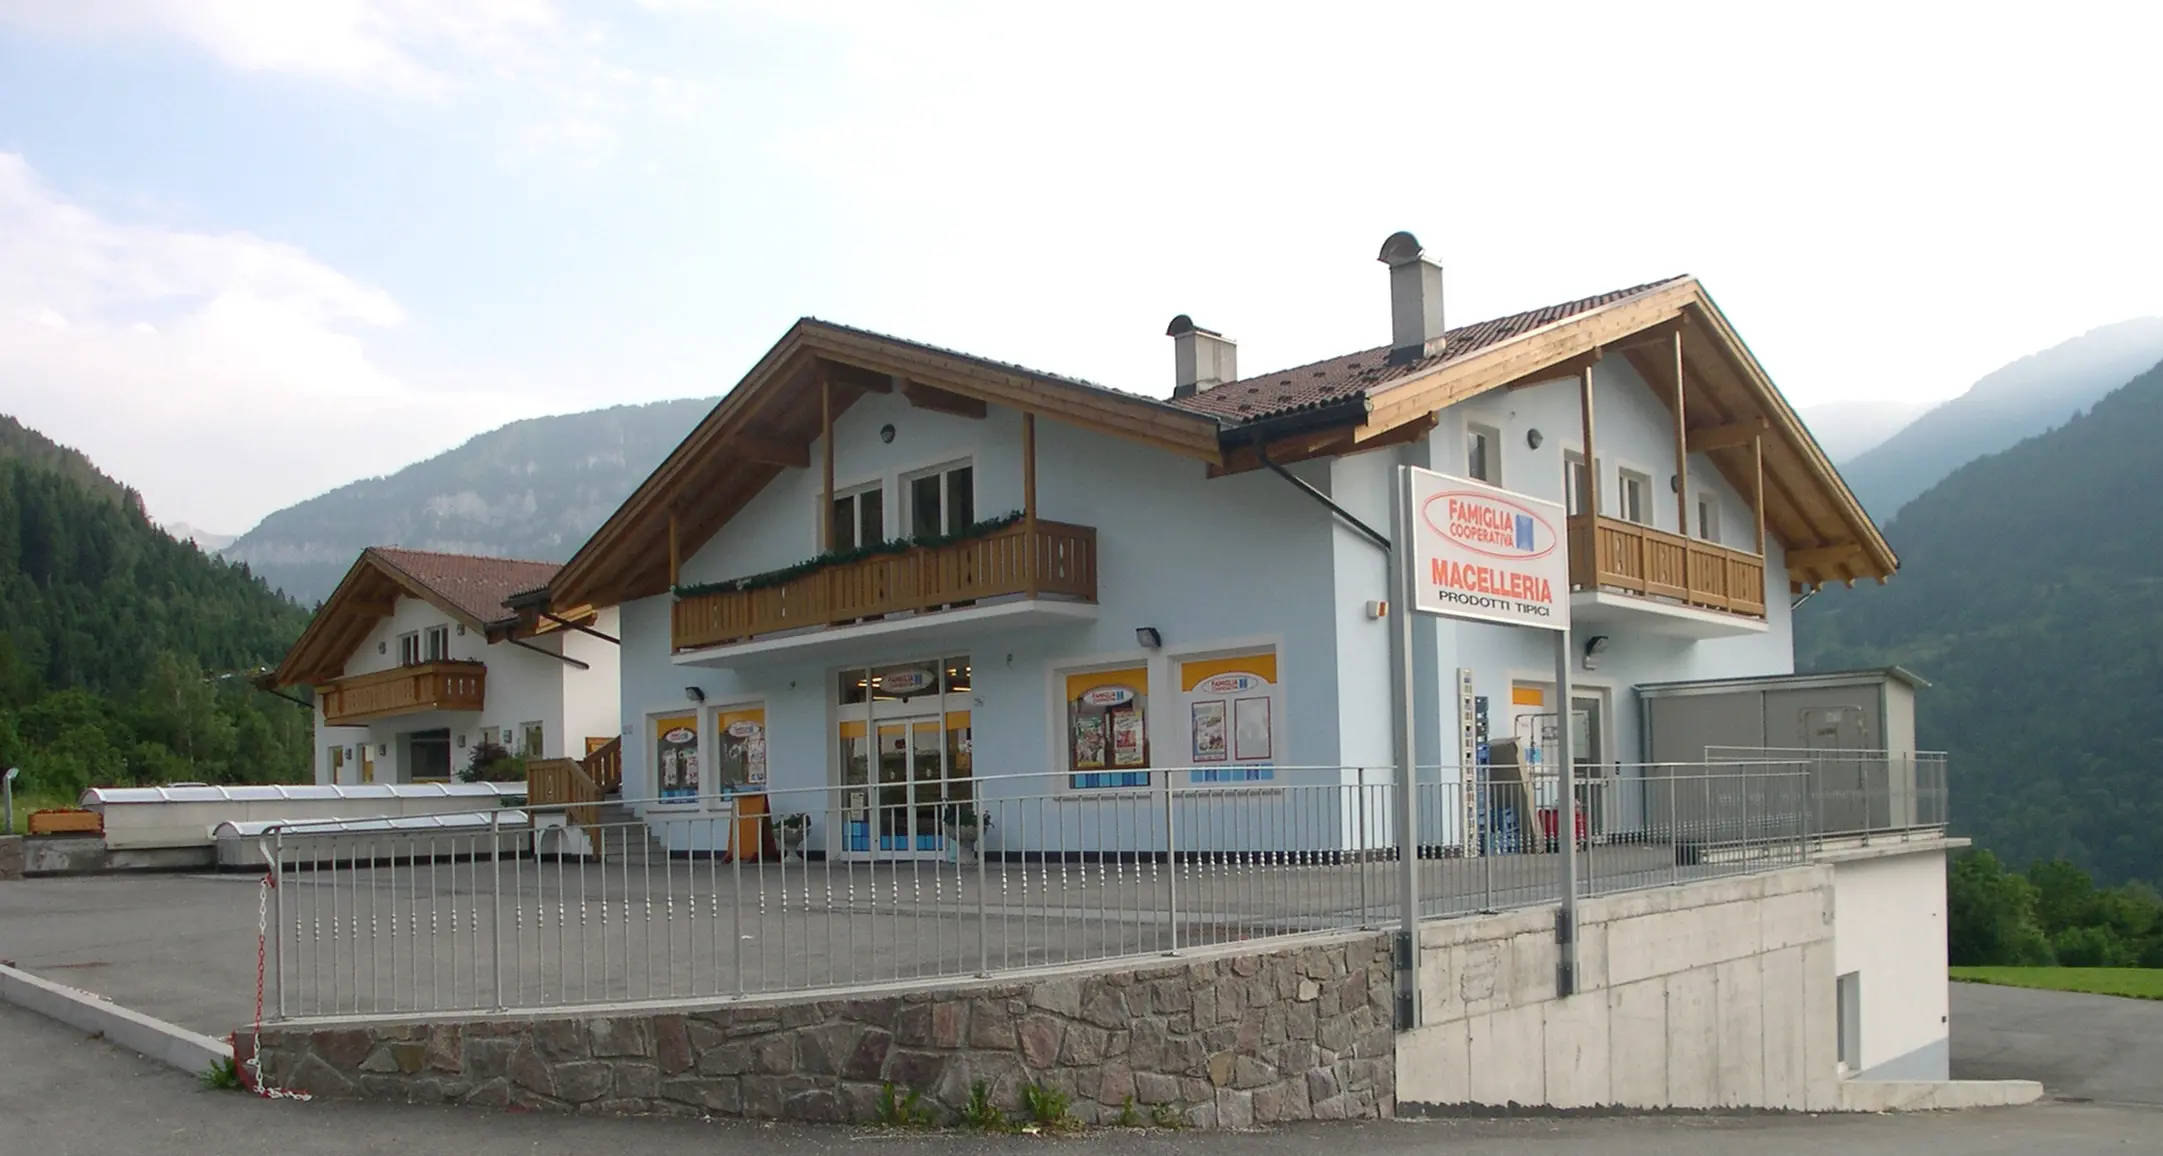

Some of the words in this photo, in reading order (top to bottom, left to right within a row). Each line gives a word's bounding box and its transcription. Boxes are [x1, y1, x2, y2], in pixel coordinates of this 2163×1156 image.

[1449, 498, 1513, 532] FAMIGLIA
[1450, 522, 1514, 548] COOPERATIVA
[1431, 558, 1552, 604] MACELLERIA
[1439, 590, 1510, 611] PRODOTTI
[1516, 602, 1550, 617] TIPICI
